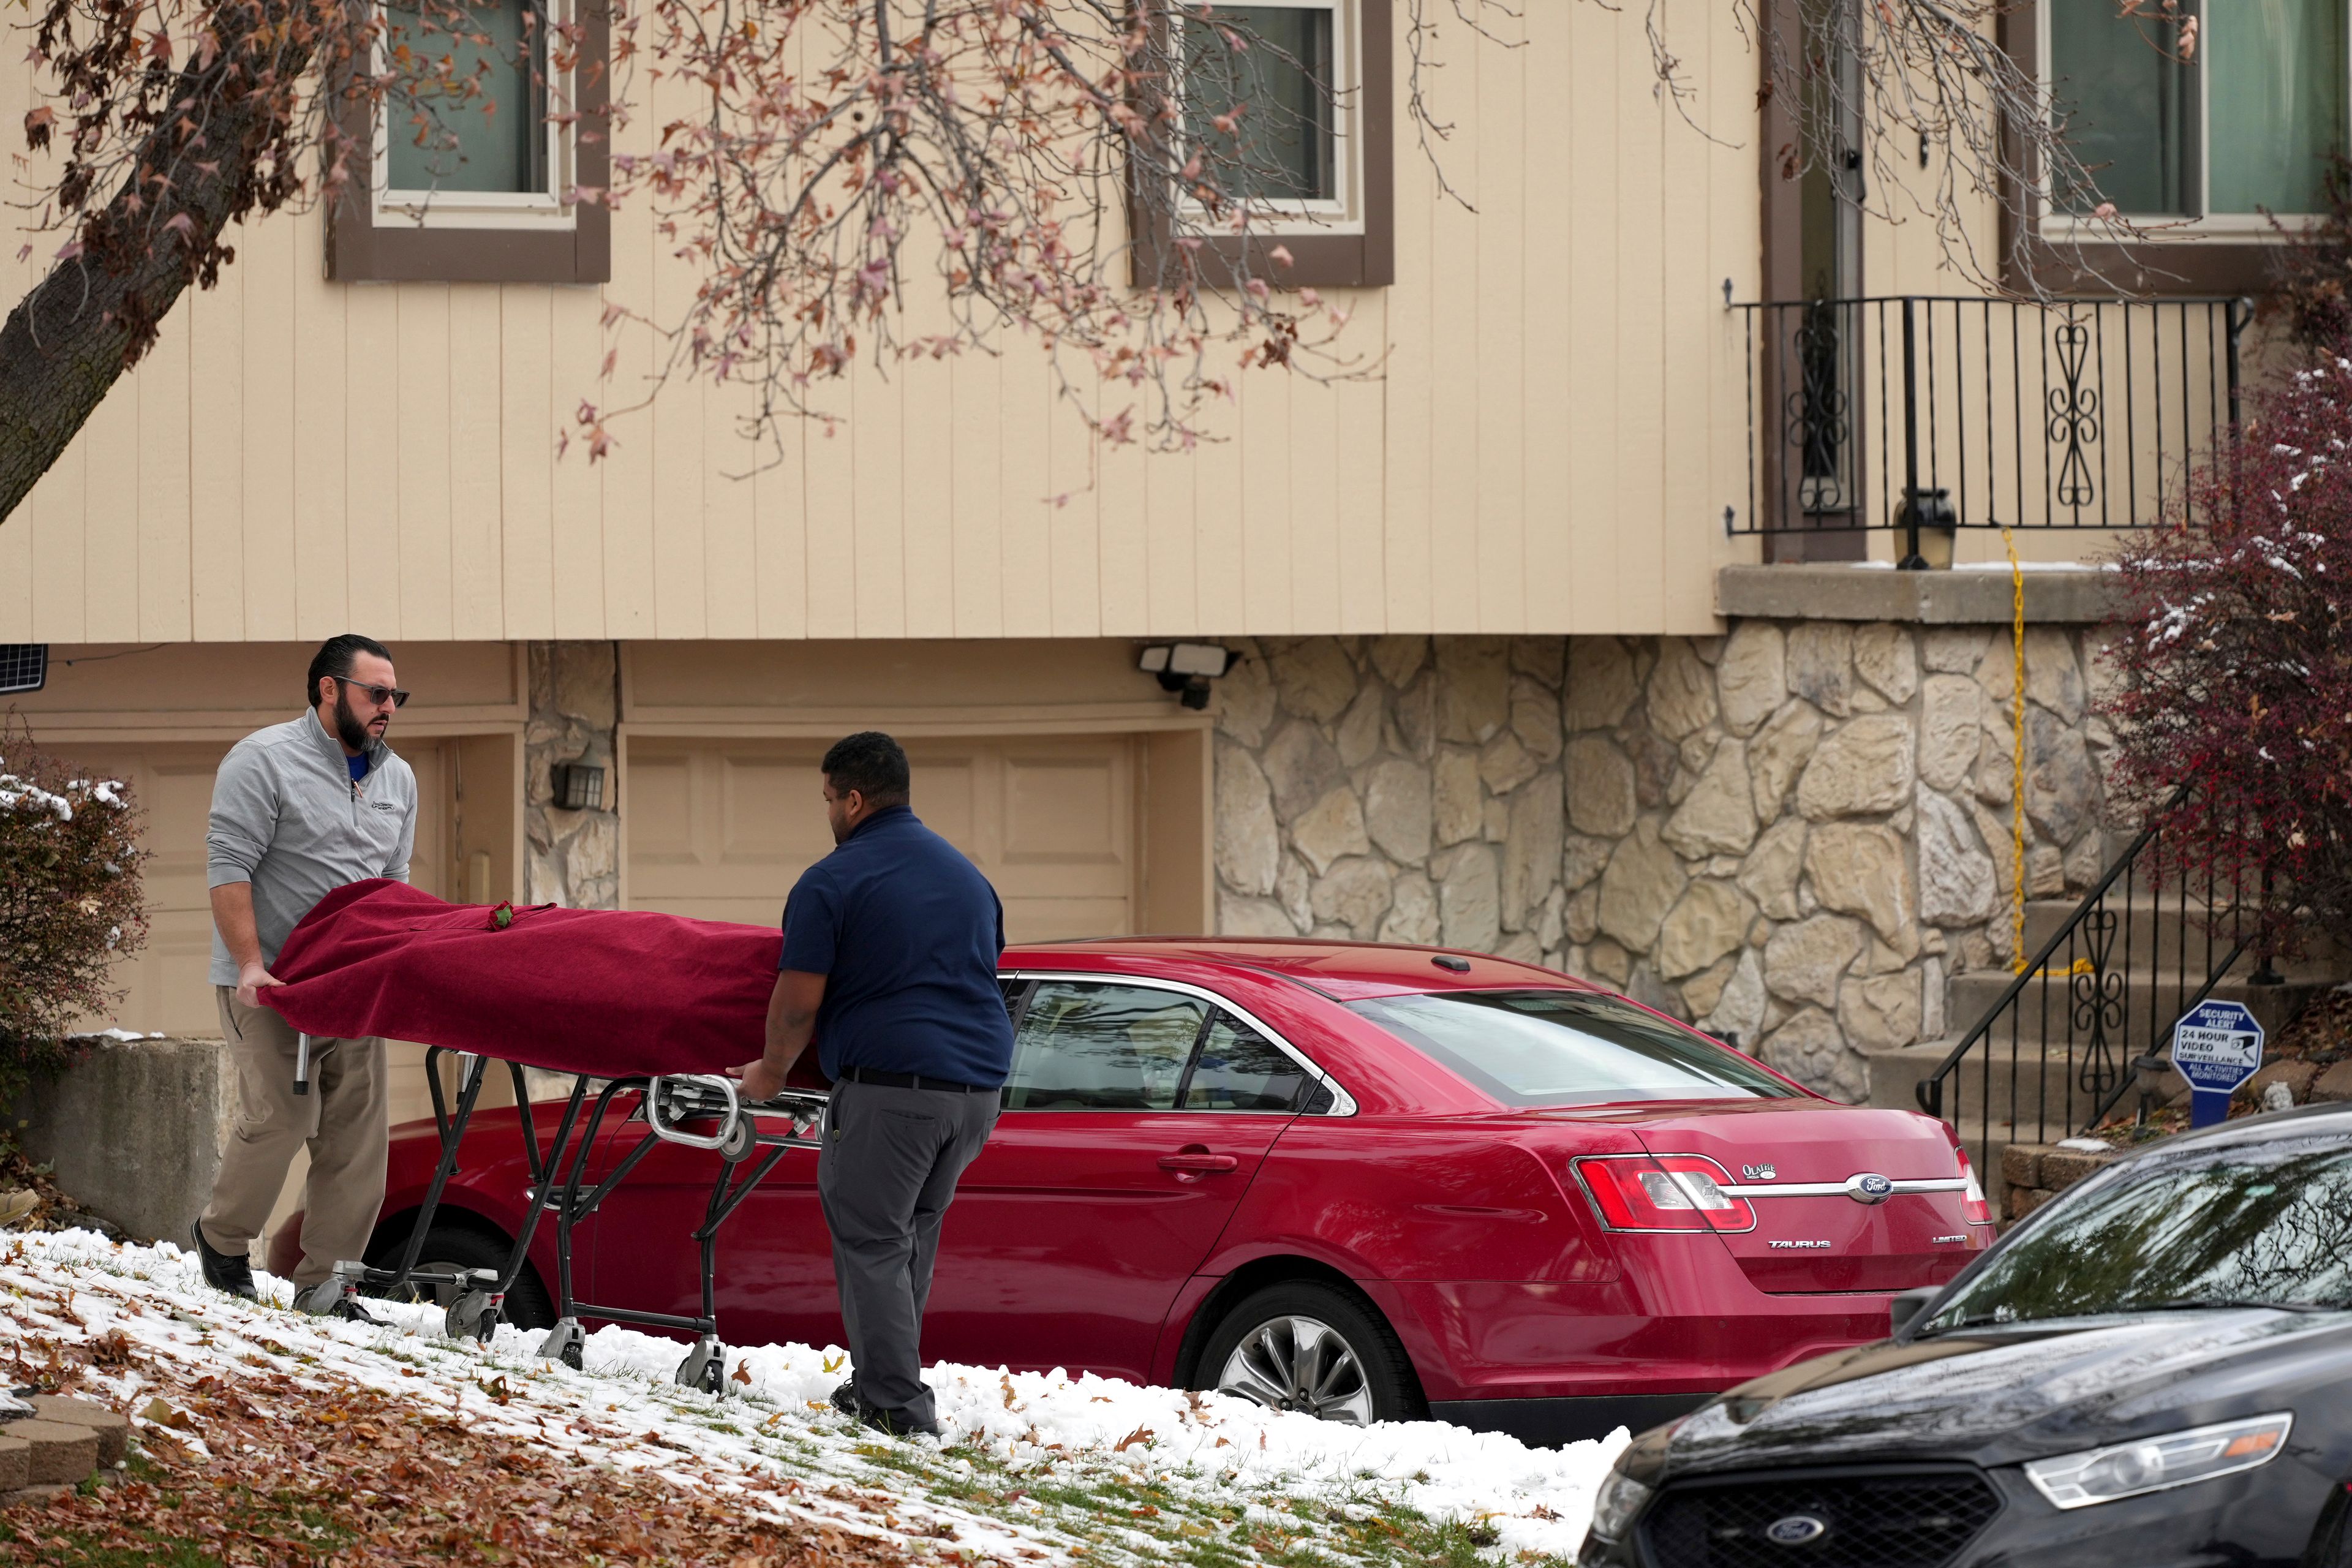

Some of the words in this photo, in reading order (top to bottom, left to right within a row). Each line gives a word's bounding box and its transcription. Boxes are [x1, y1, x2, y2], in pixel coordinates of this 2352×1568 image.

[2199, 1009, 2244, 1021] SECURITY
[2206, 1019, 2236, 1029] ALERT
[2182, 1030, 2195, 1039] 24
[2198, 1032, 2229, 1042] HOUR
[2181, 1041, 2214, 1052] VIDEO
[2179, 1052, 2244, 1065] SURVEILLANCE
[2204, 1065, 2244, 1076] ACTIVITIES
[2191, 1071, 2237, 1082] MONITORED
[1743, 1164, 1776, 1175] OLATHE
[1866, 1178, 1887, 1191] Ford
[1932, 1235, 1967, 1243] LIMITED
